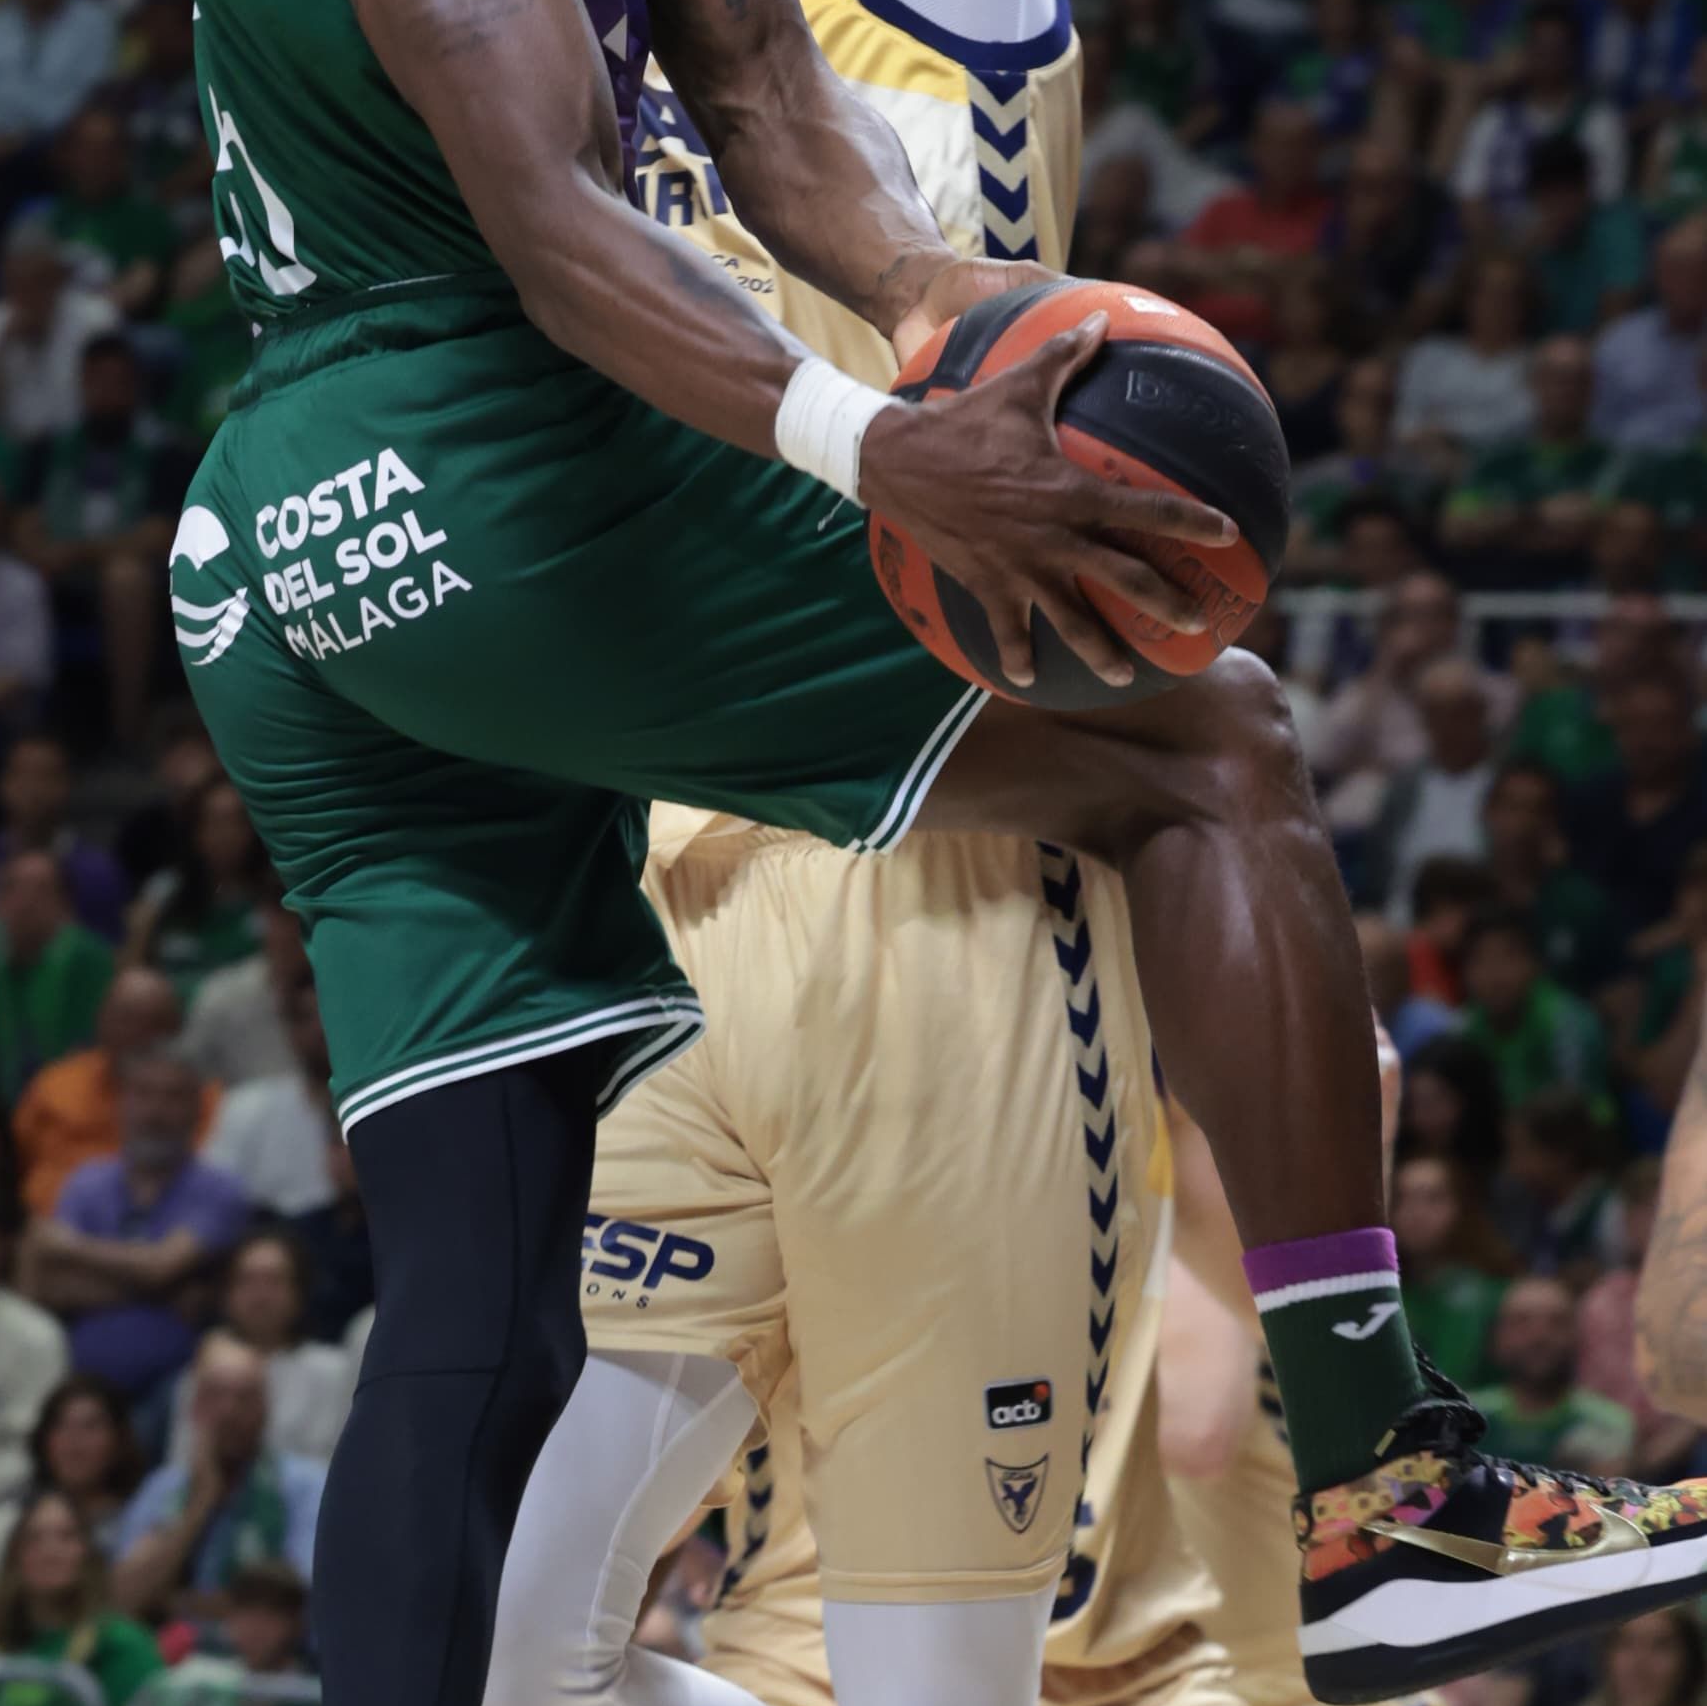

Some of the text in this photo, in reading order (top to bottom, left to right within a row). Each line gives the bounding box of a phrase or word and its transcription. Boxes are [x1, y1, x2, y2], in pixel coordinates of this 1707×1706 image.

[256, 447, 426, 559] COSTA
[263, 509, 447, 615] DEL SOL
[285, 560, 473, 660] MÁLAGA
[992, 1399, 1041, 1425] acb
